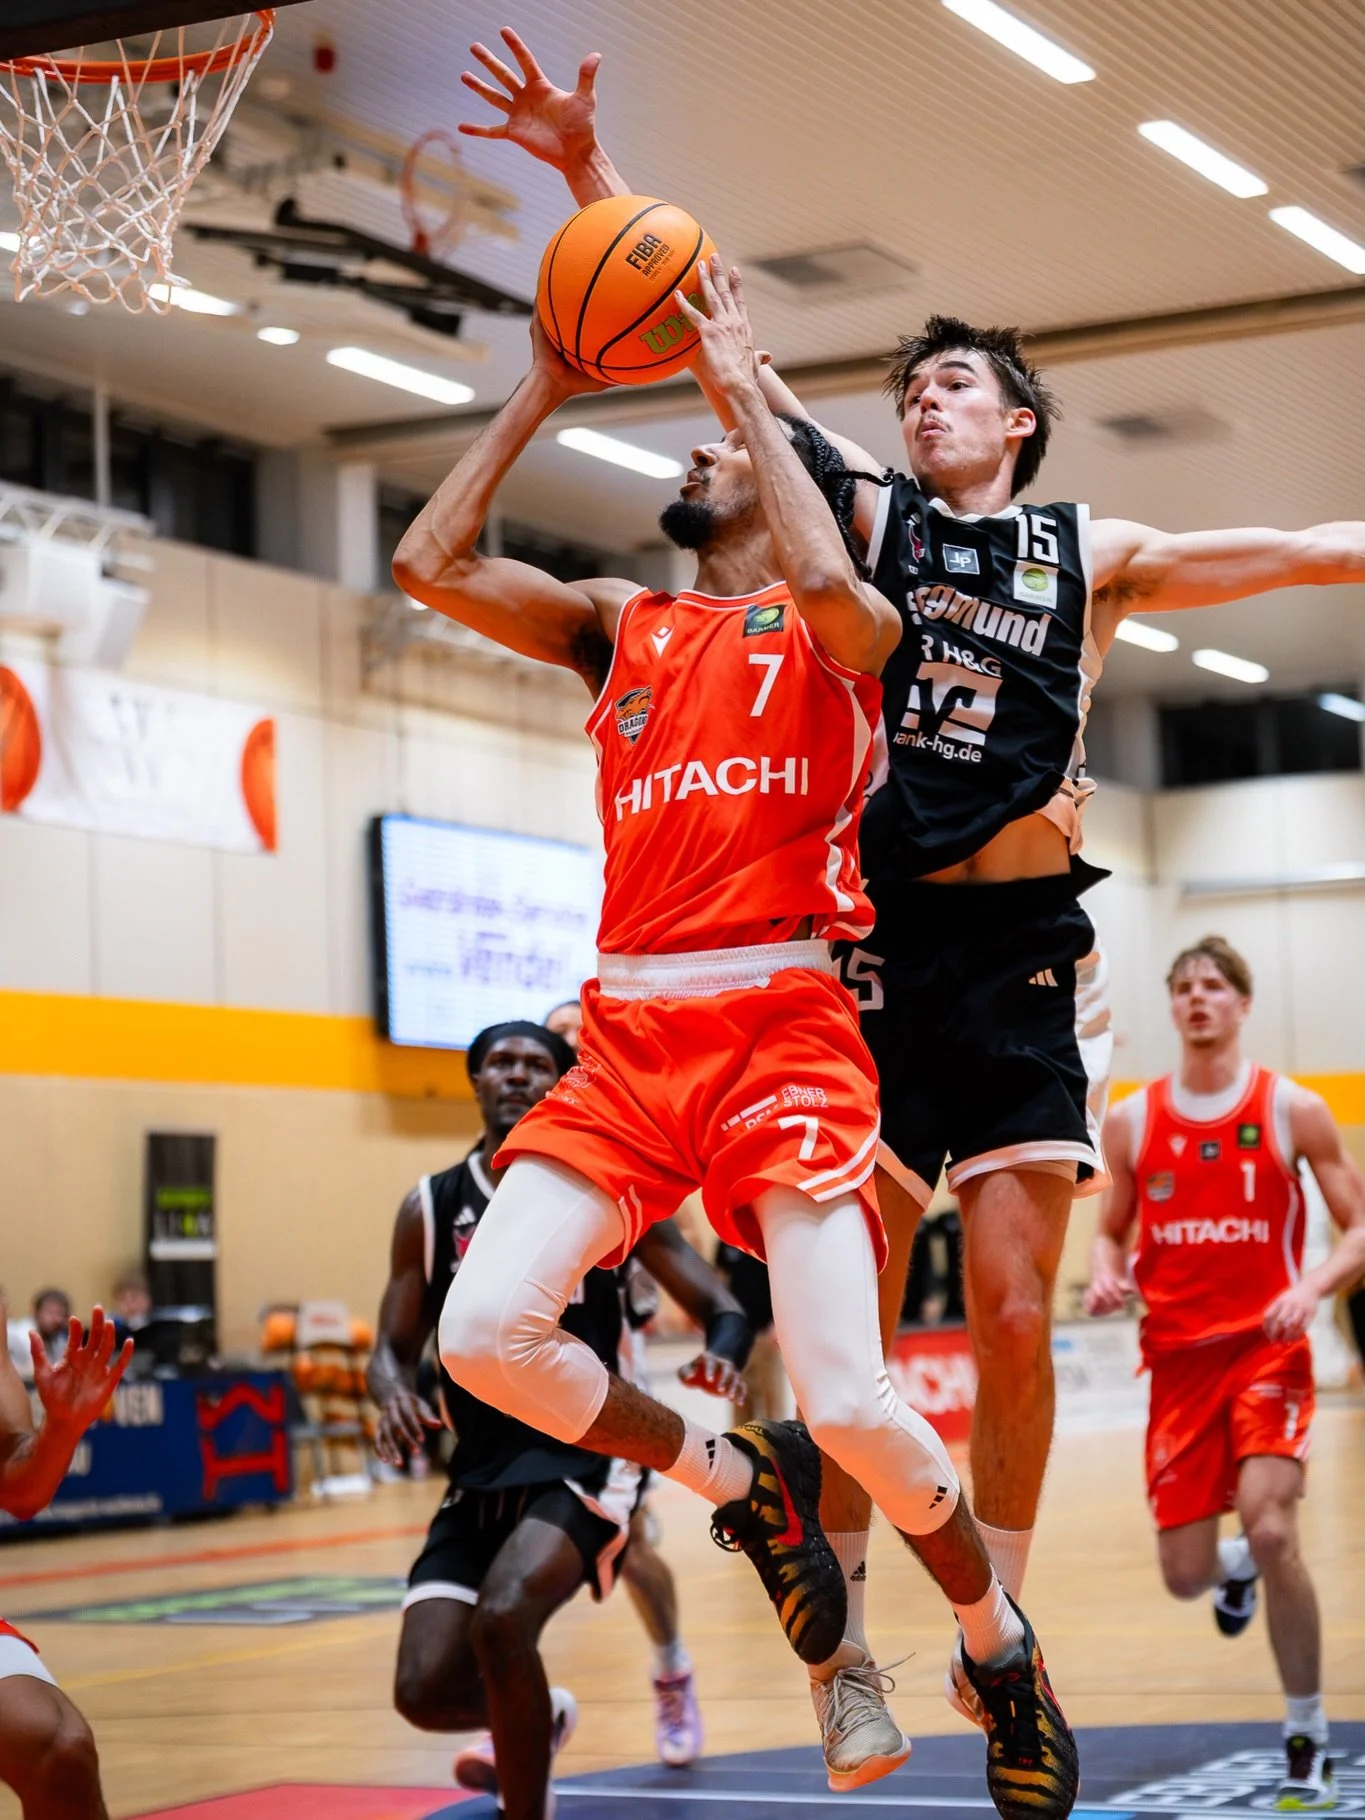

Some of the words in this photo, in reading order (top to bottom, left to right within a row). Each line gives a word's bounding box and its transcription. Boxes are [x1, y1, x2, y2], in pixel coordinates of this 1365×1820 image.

[625, 234, 662, 270] FIBA
[642, 244, 670, 277] APPROVED
[1015, 513, 1060, 564] 15
[942, 640, 1003, 678] H&G
[748, 653, 785, 717] 7
[892, 731, 982, 763] ank-hg.de
[614, 756, 808, 822] HITACHI
[781, 1085, 826, 1100] EBNER
[783, 1096, 829, 1108] STOLZ
[777, 1114, 819, 1160] 7
[1241, 1160, 1257, 1202] 1
[1151, 1217, 1270, 1244] HITACHI
